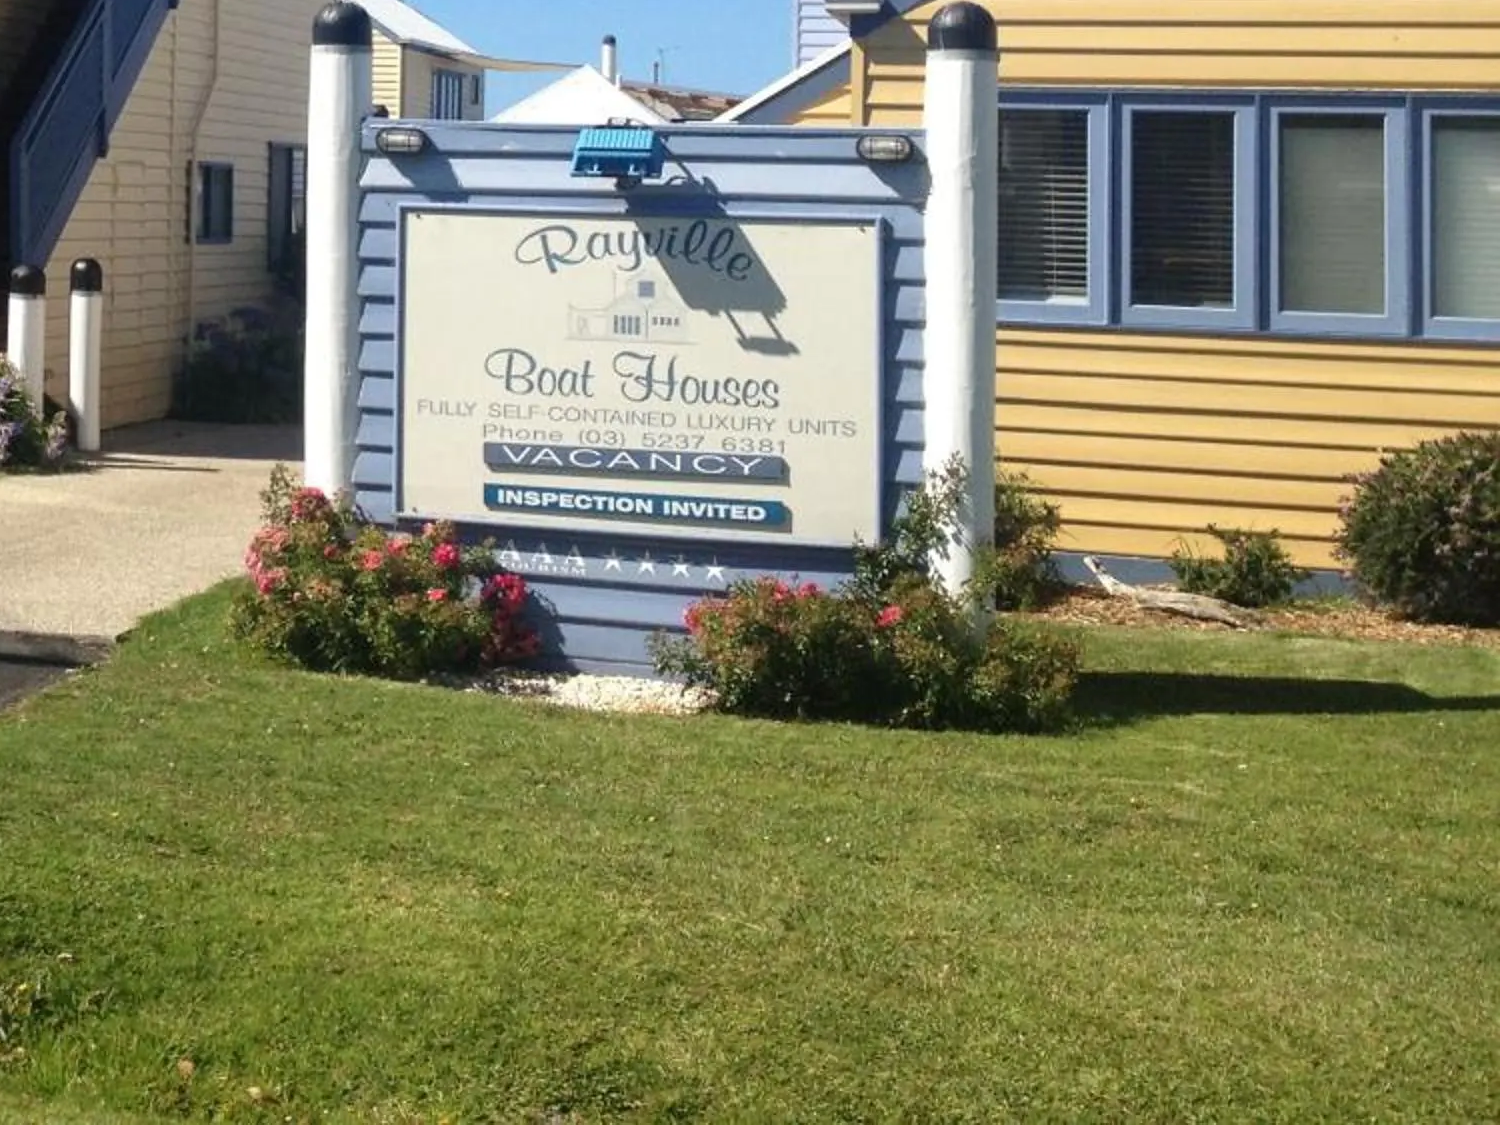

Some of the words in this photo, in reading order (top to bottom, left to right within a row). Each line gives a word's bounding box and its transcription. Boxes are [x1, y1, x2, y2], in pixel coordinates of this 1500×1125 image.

[515, 219, 753, 281] Rayville
[484, 348, 595, 397] Boat
[613, 351, 779, 409] Houses
[417, 399, 477, 417] FULLY
[488, 402, 676, 428] SELF-CONTAINED
[687, 412, 776, 433] LUXURY
[789, 418, 857, 438] UNITS
[483, 424, 563, 442] Phone
[579, 429, 626, 446] (03)
[642, 432, 706, 450] 5237
[720, 437, 786, 455] 6381
[502, 444, 763, 476] VACANCY
[497, 488, 653, 515] INSPECTION
[663, 500, 768, 521] INVITED
